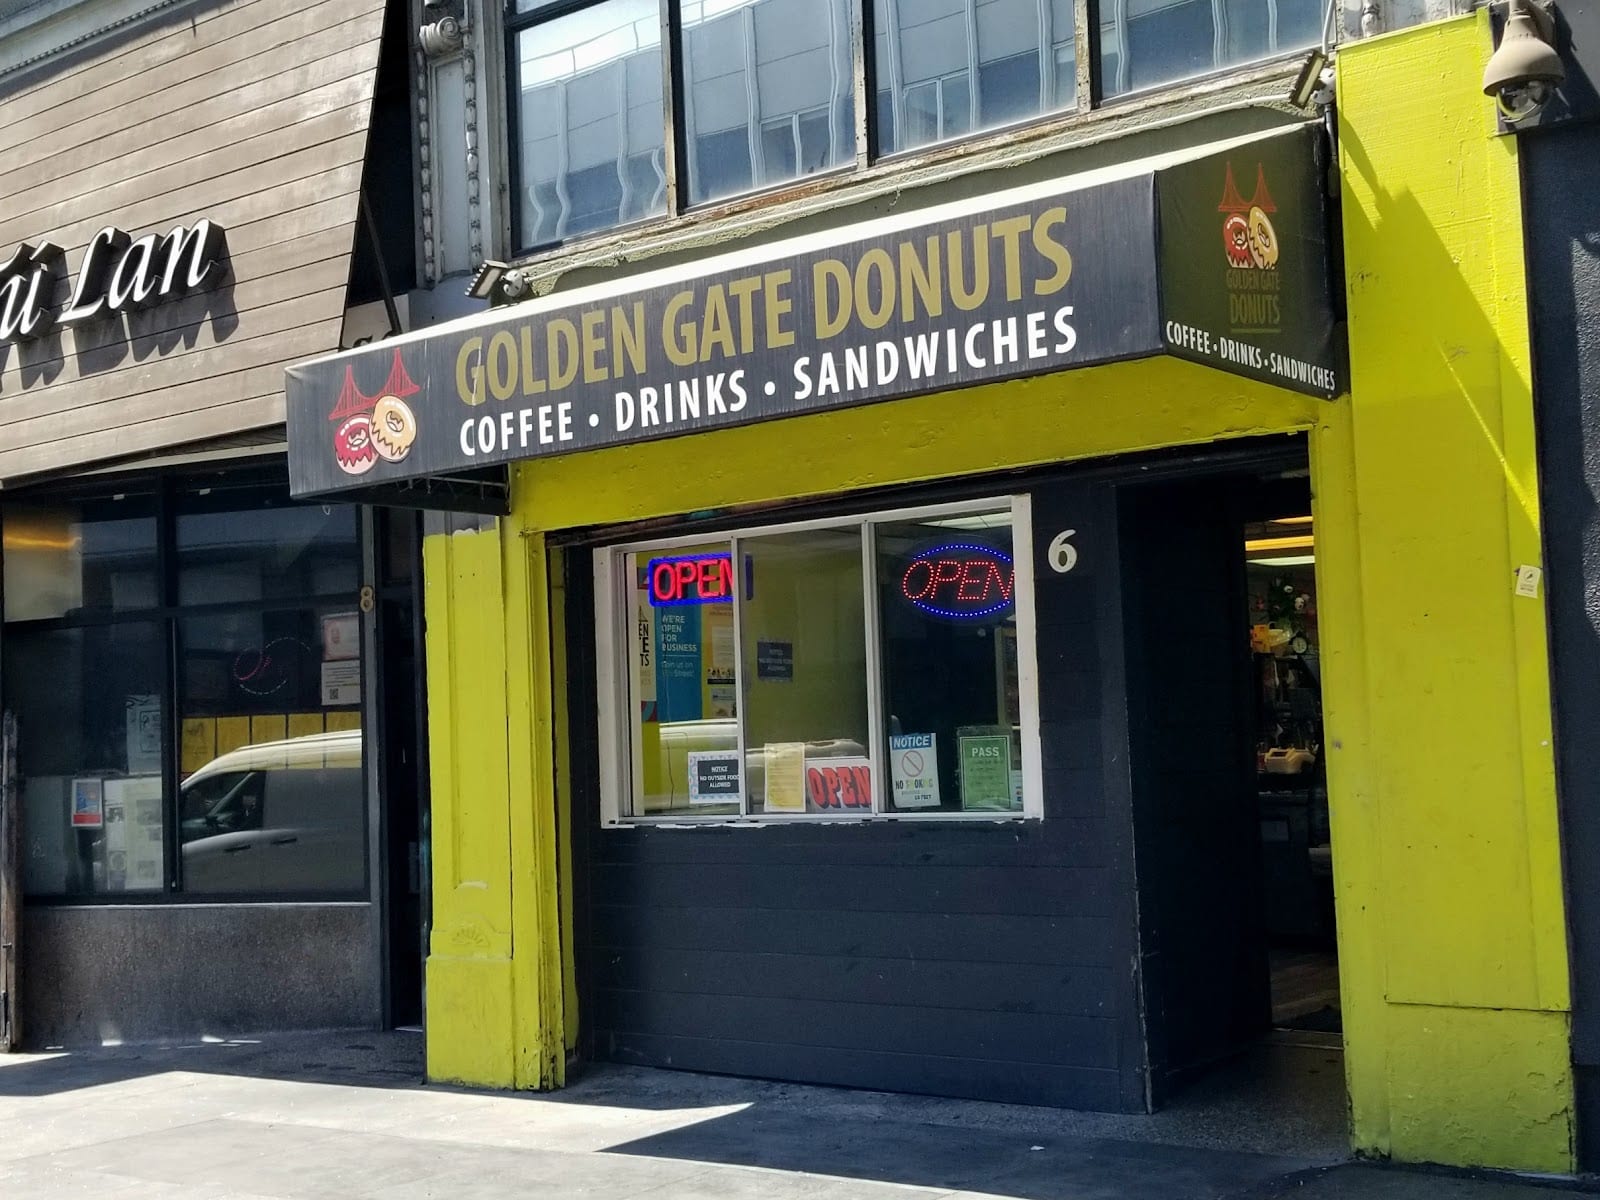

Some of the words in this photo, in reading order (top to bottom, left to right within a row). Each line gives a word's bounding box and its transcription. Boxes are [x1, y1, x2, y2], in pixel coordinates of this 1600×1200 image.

[55, 218, 217, 323] Lan
[1226, 269, 1259, 290] GOLDEN
[1260, 270, 1280, 291] GATE
[455, 301, 647, 406] GOLDEN
[662, 269, 795, 367] GATE
[813, 207, 1073, 339] DONUTS
[1230, 292, 1280, 324] DONUTS
[1166, 320, 1211, 354] COFFEE
[1220, 337, 1262, 369] DRINKS
[1270, 352, 1336, 391] SANDWICHES
[459, 402, 574, 457] COFFEE
[615, 370, 748, 432] DRINKS
[793, 305, 1077, 401] SANDWICHES
[1047, 529, 1078, 573] 6
[653, 558, 734, 601] OPEN
[902, 560, 1015, 600] OPEN
[661, 624, 682, 633] OPEN
[662, 643, 697, 652] BUSINESS
[893, 736, 930, 748] NOTICE
[971, 746, 1000, 758] PASS
[711, 765, 729, 773] NOTICE
[895, 780, 904, 790] NO
[807, 766, 871, 809] OPEN
